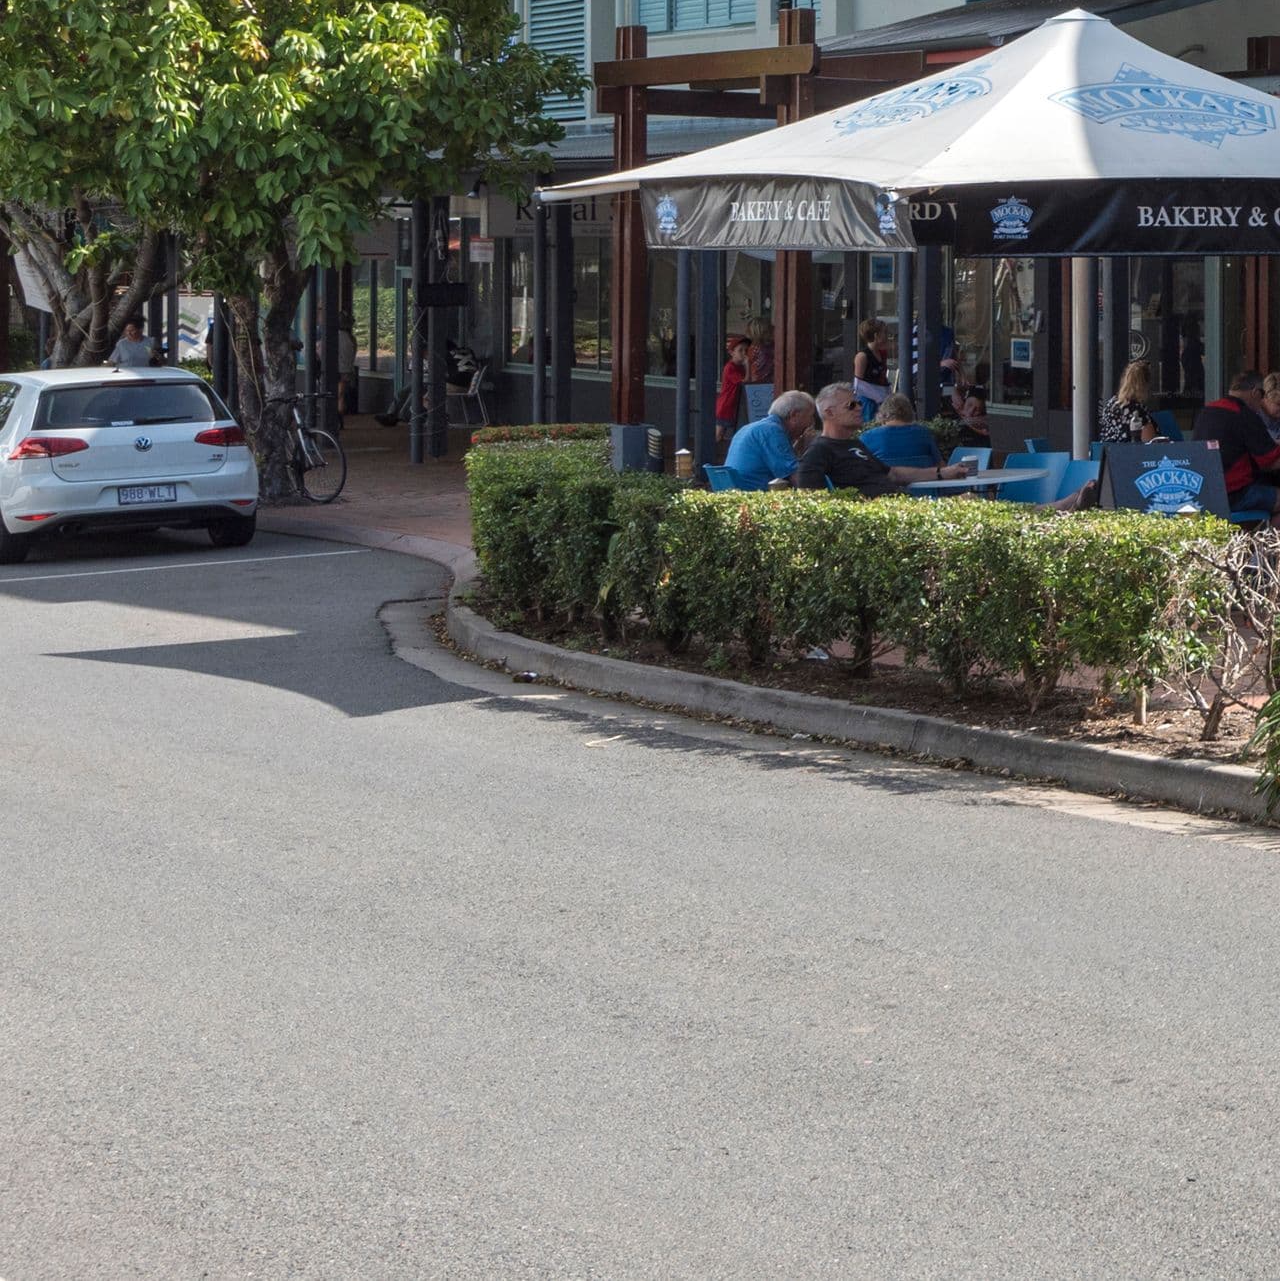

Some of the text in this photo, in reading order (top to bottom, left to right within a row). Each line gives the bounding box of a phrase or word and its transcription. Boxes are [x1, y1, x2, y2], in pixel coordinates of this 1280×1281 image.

[731, 194, 831, 222] BAKERY & CAFÉ
[1137, 206, 1242, 227] BAKERY
[1248, 206, 1269, 227] &
[1138, 470, 1200, 493] MOCKA'S
